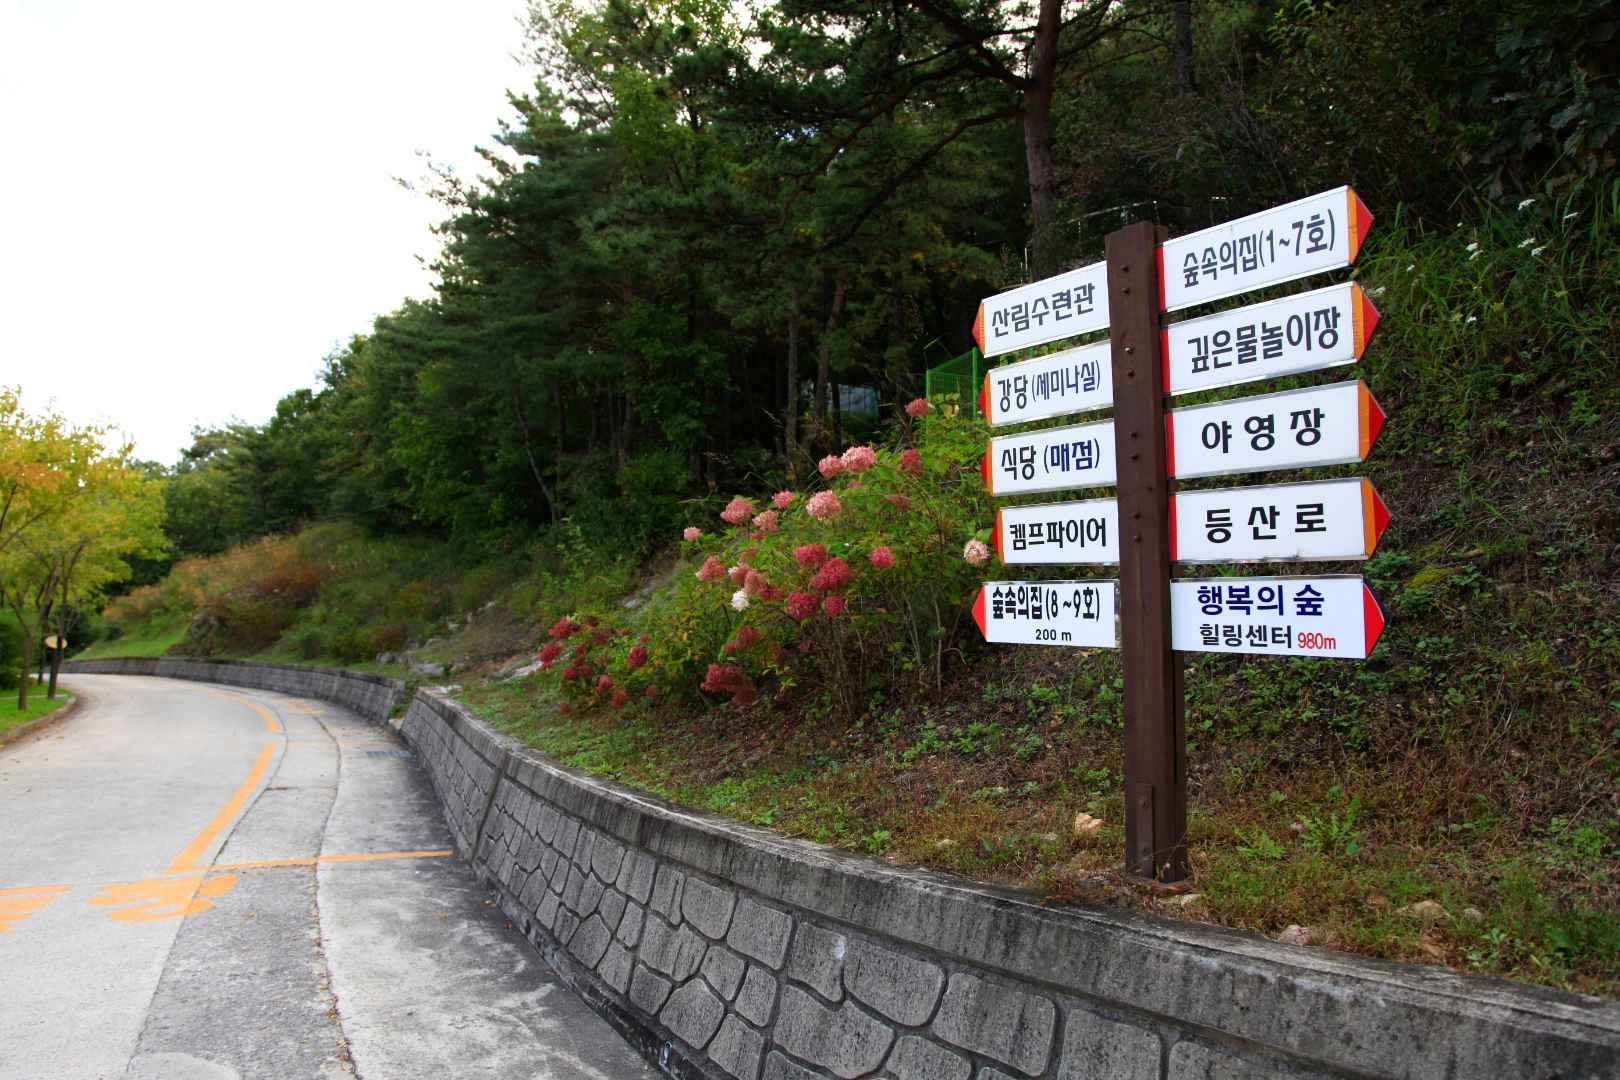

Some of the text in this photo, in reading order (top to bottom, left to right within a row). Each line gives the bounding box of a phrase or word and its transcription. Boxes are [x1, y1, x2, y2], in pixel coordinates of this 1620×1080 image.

[1183, 209, 1335, 288] 숲속의집(1~7호)
[992, 282, 1095, 337] 산림수련관
[1188, 306, 1340, 373] 깊은물놀이장
[1200, 624, 1337, 650] 힐링센터 980m
